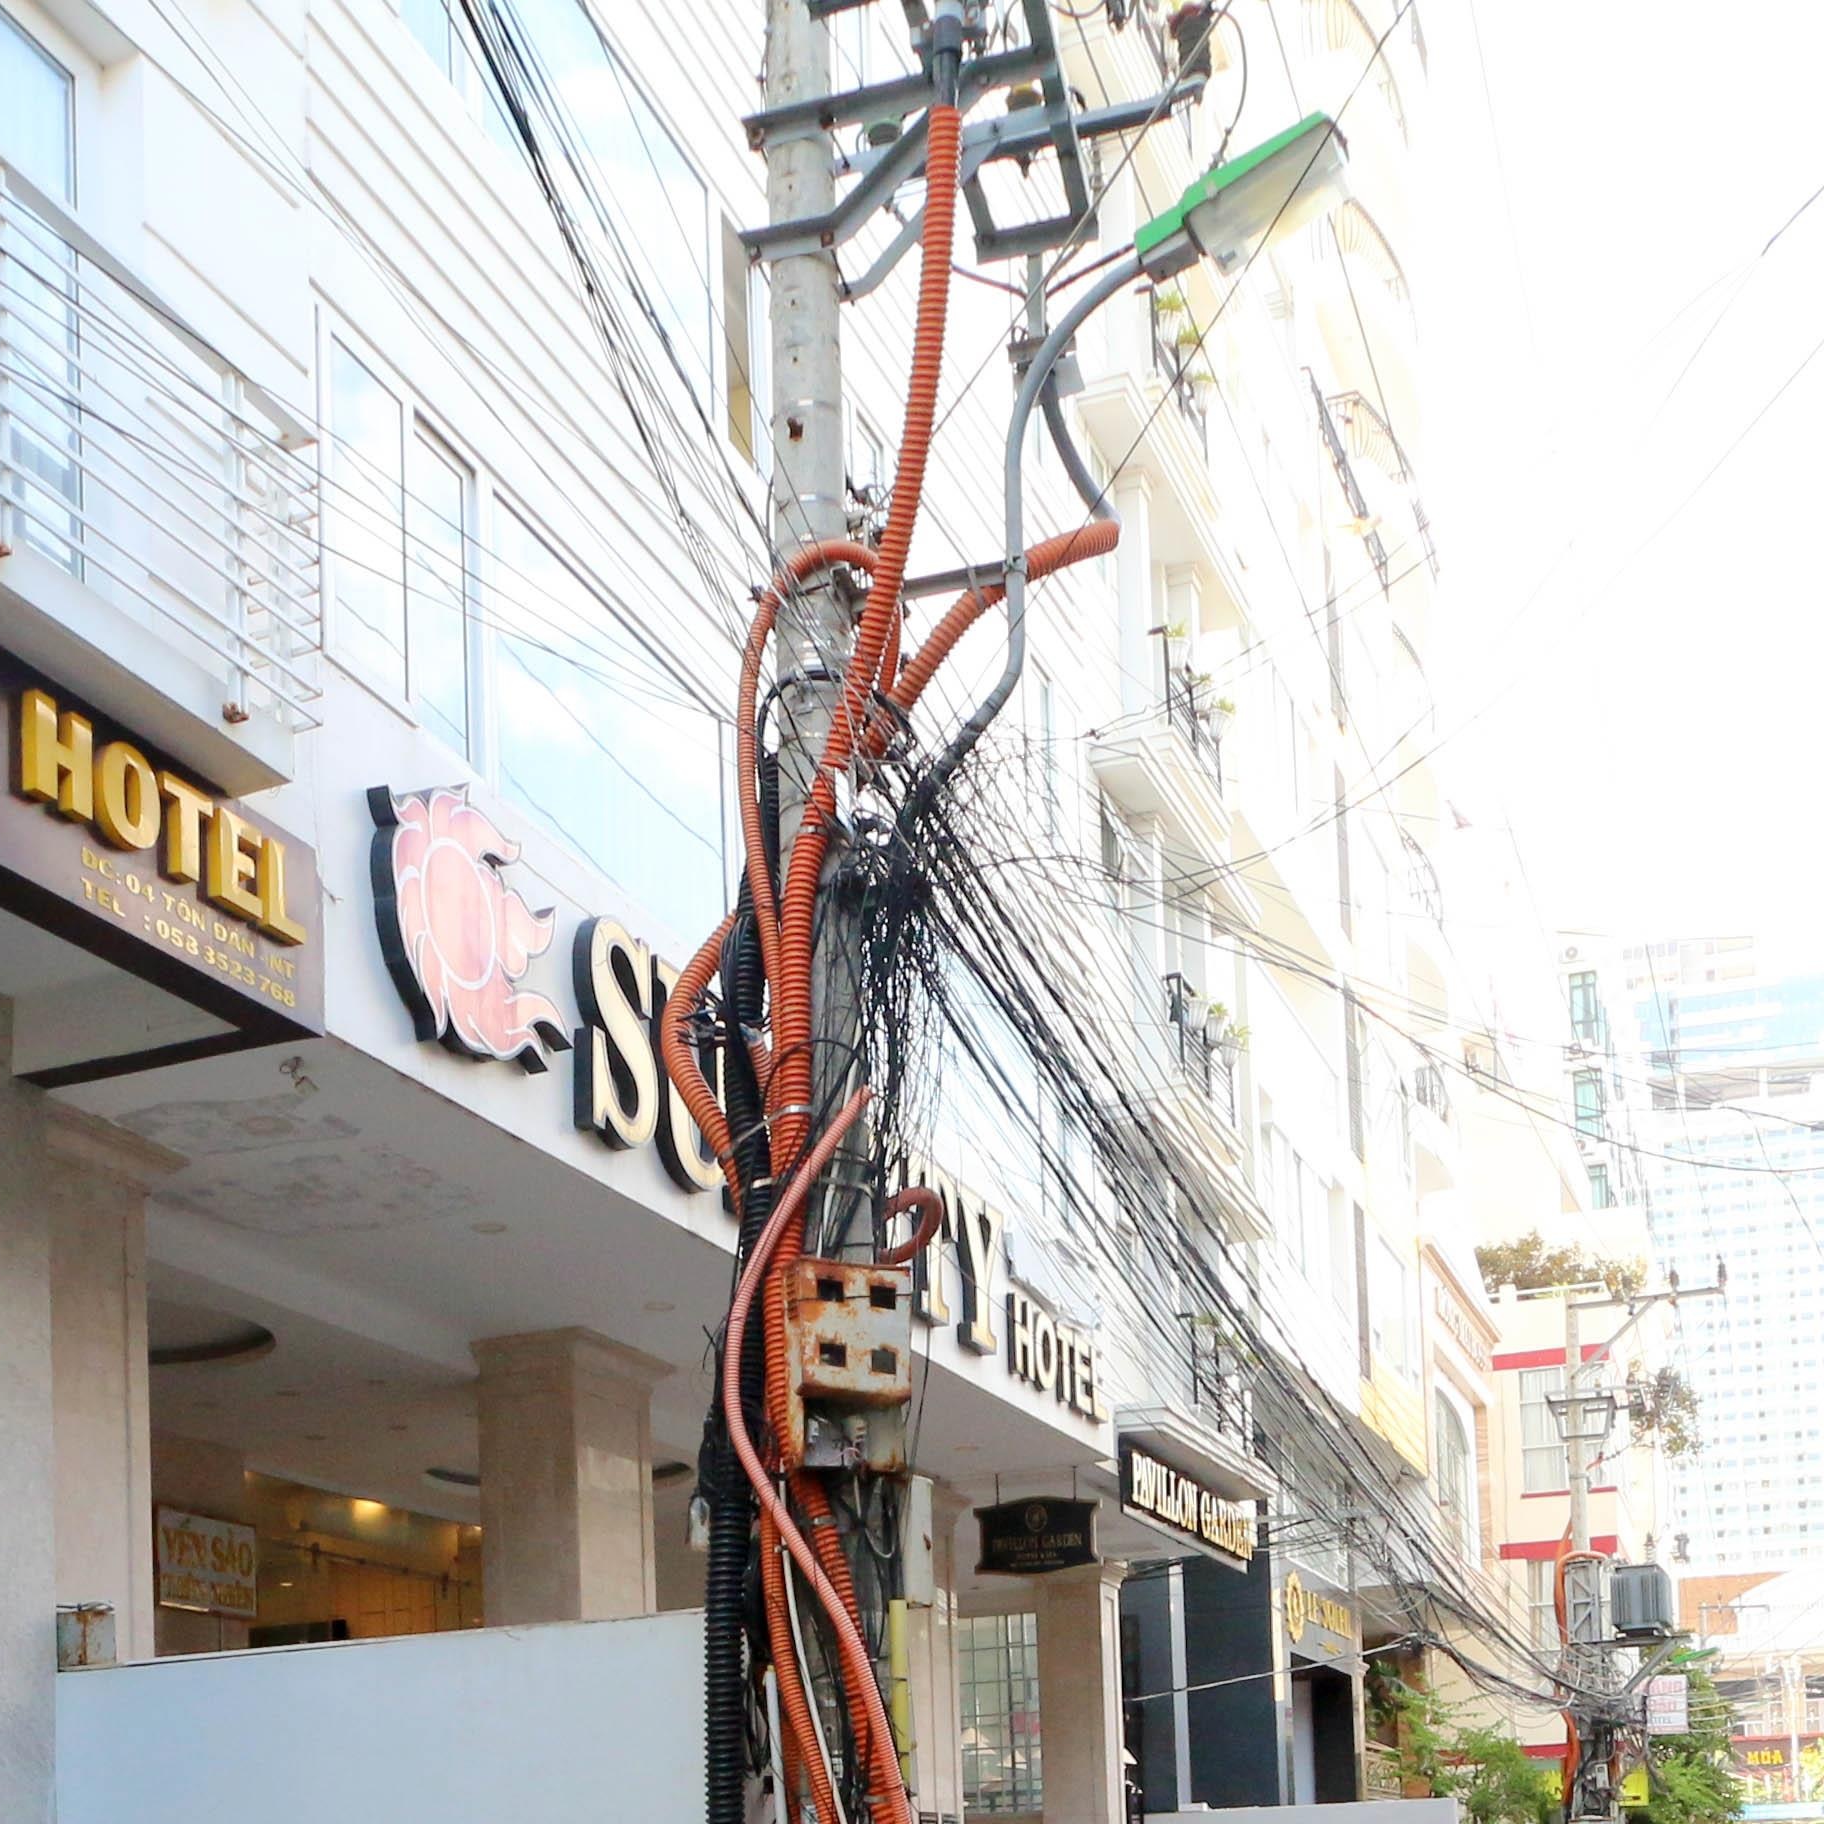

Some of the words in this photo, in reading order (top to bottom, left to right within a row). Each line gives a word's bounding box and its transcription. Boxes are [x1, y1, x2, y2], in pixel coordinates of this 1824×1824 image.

[22, 689, 307, 946] HOTEL
[80, 877, 126, 918] TEL
[1006, 1292, 1108, 1424] HOTEL
[1131, 1450, 1198, 1532] PAVILLON
[1200, 1490, 1253, 1561] GARDEN
